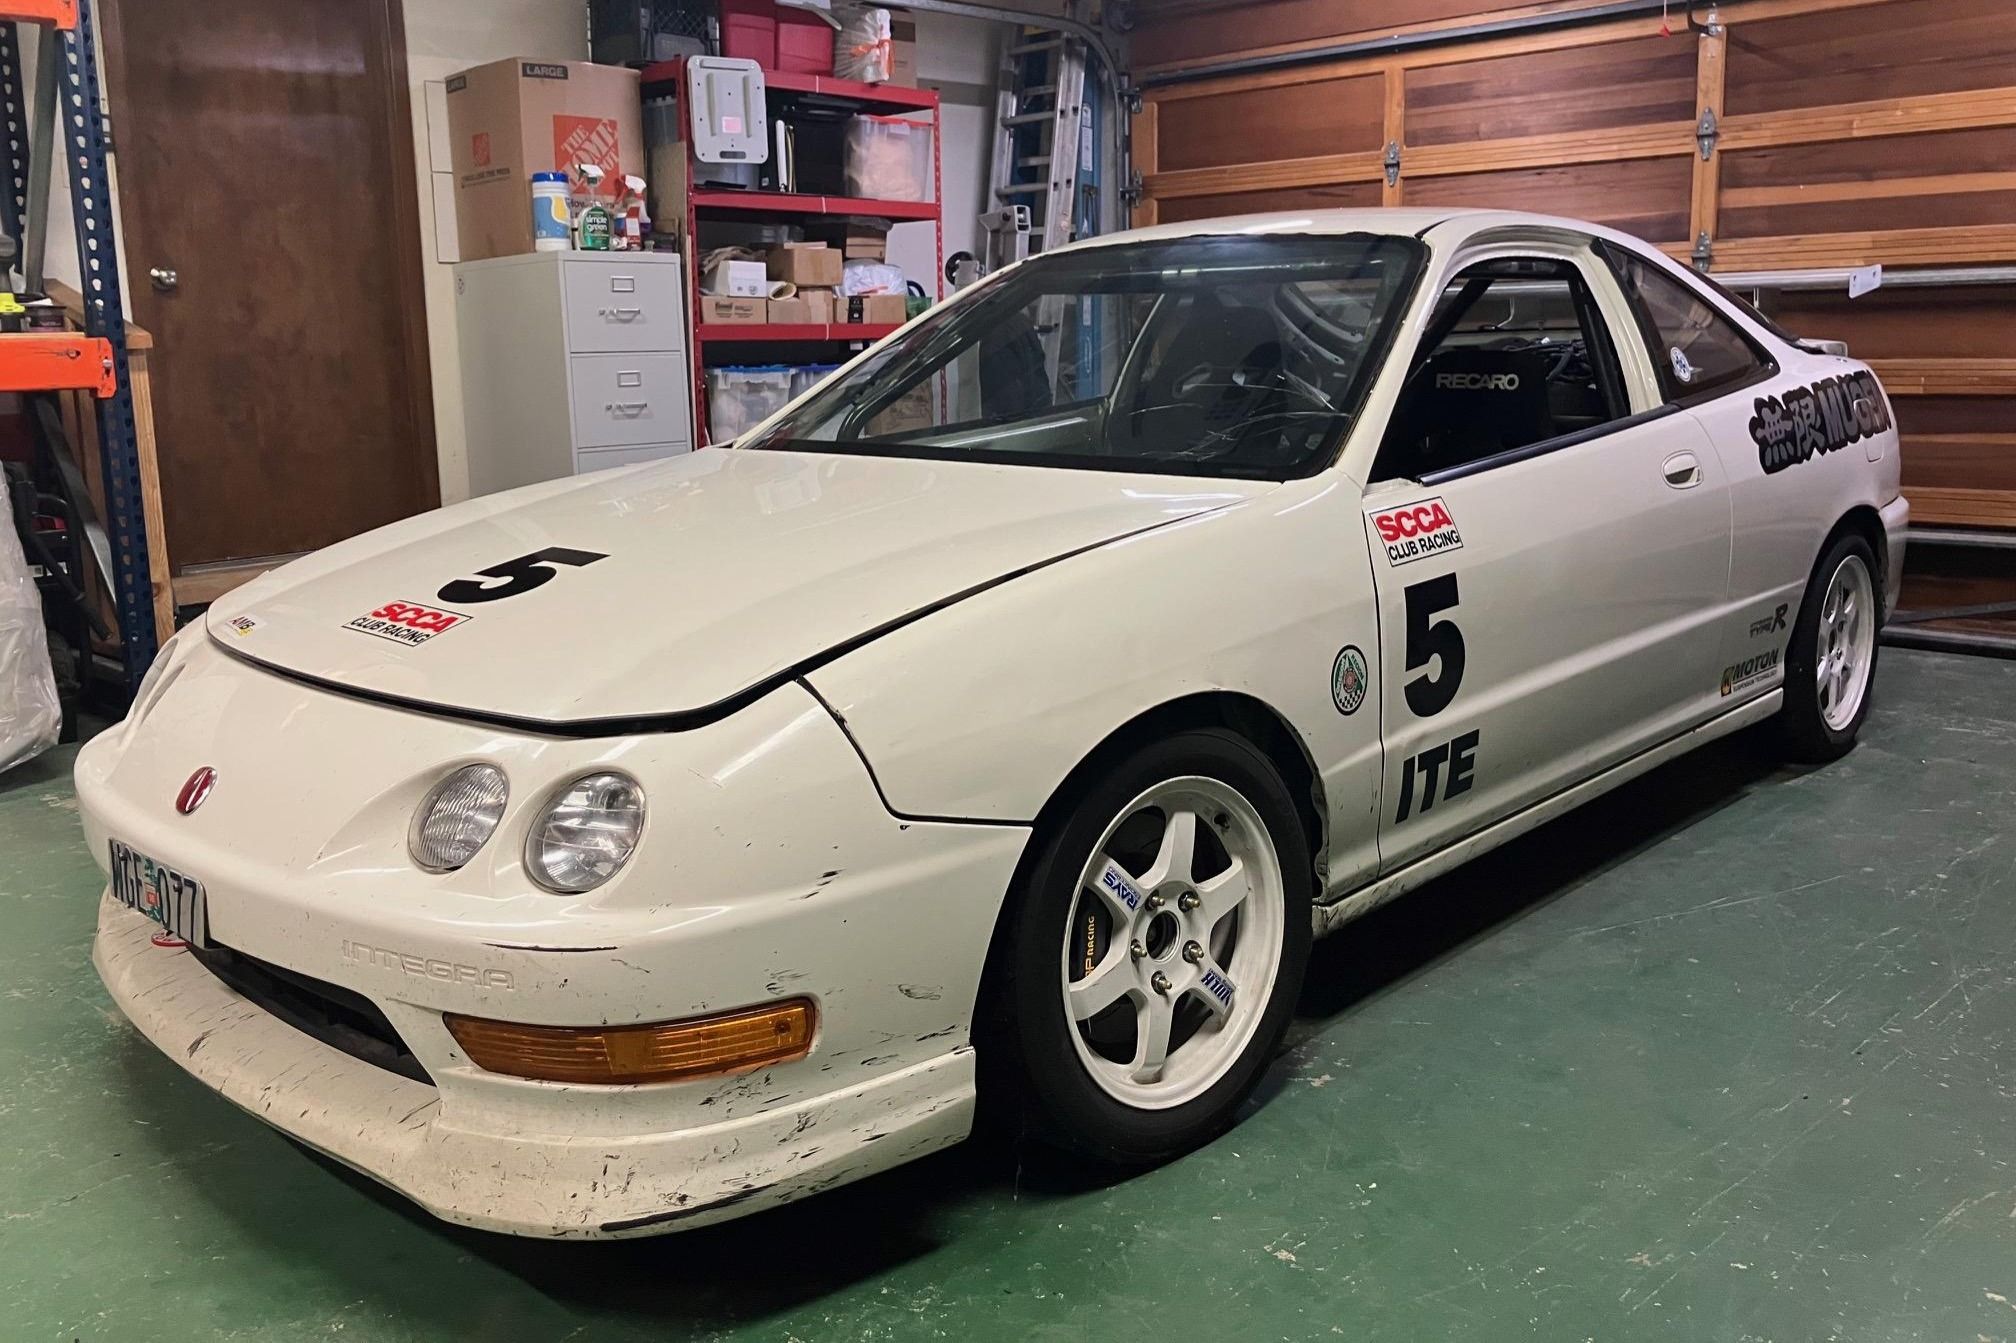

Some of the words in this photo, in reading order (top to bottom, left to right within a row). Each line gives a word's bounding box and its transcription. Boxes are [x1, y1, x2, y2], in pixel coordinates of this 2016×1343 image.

[526, 64, 565, 78] LARGE
[561, 124, 590, 155] THE
[585, 215, 608, 225] simple
[587, 223, 608, 233] green
[1435, 372, 1520, 391] RECARO
[1375, 502, 1453, 542] SCCA
[1388, 540, 1419, 561] CLUB
[1417, 529, 1460, 553] RACING
[437, 546, 611, 604] 5
[350, 616, 387, 632] CLUB
[378, 624, 431, 643] RACING
[371, 603, 459, 633] SCCA
[1770, 602, 1789, 634] R
[1403, 571, 1466, 718] 5
[1732, 647, 1779, 680] MOTON
[1394, 728, 1480, 825] ITE
[157, 866, 198, 943] 077
[1103, 871, 1138, 911] RAYS
[341, 937, 516, 991] INTEGRA
